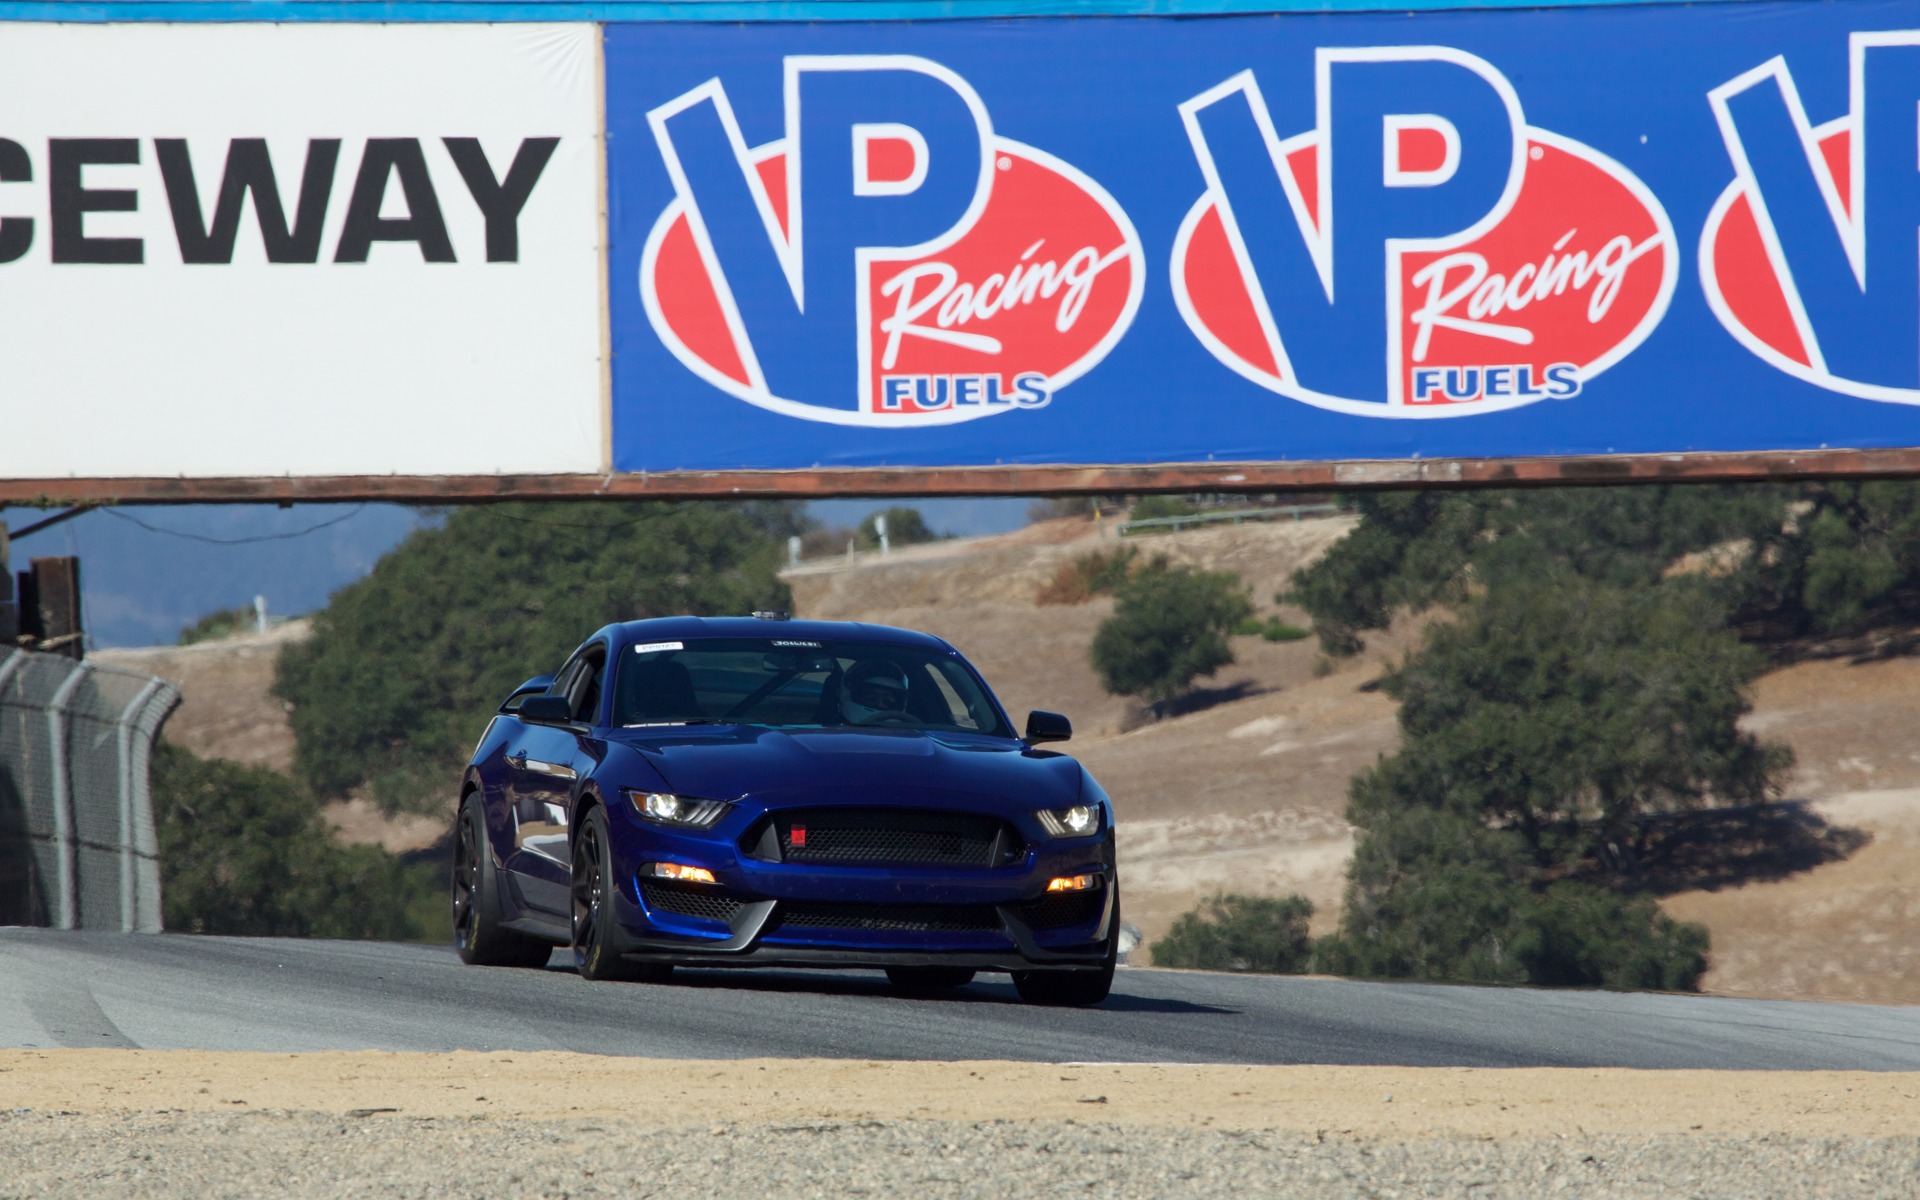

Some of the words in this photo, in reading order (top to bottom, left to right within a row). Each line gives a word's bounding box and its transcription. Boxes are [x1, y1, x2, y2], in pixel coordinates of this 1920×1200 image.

[646, 54, 995, 418] VP
[1177, 45, 1527, 412] VP
[881, 239, 1130, 370] Racing
[1411, 228, 1662, 362] Racing
[881, 372, 1052, 410] FUELS
[1411, 362, 1582, 402] FUELS
